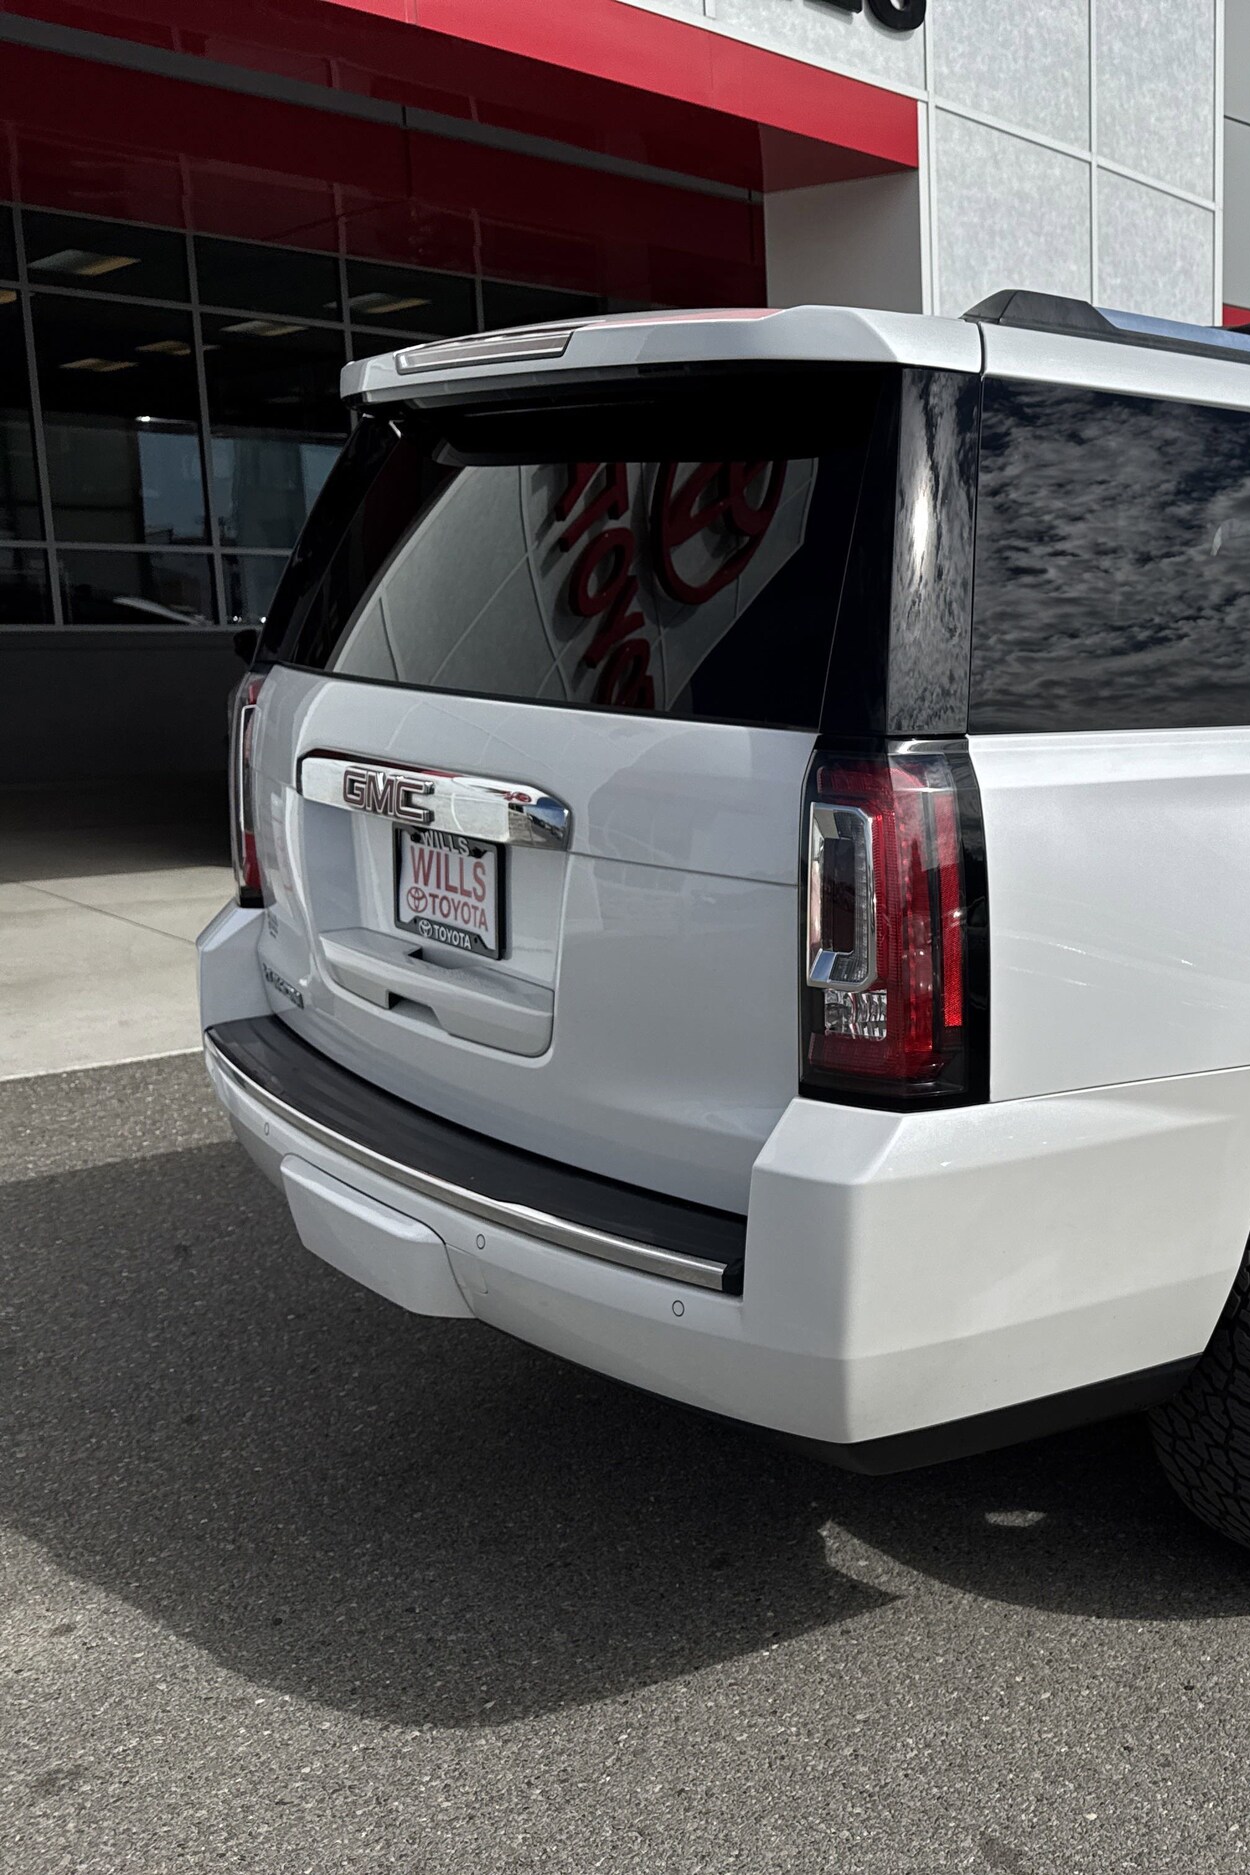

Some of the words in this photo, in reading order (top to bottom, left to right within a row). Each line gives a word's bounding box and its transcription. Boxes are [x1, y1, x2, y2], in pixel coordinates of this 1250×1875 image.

[343, 766, 435, 825] GMC
[420, 829, 470, 857] WILLS
[410, 845, 486, 902] WILLS
[428, 892, 488, 932] TOYOTA
[433, 924, 472, 950] TOYOTA
